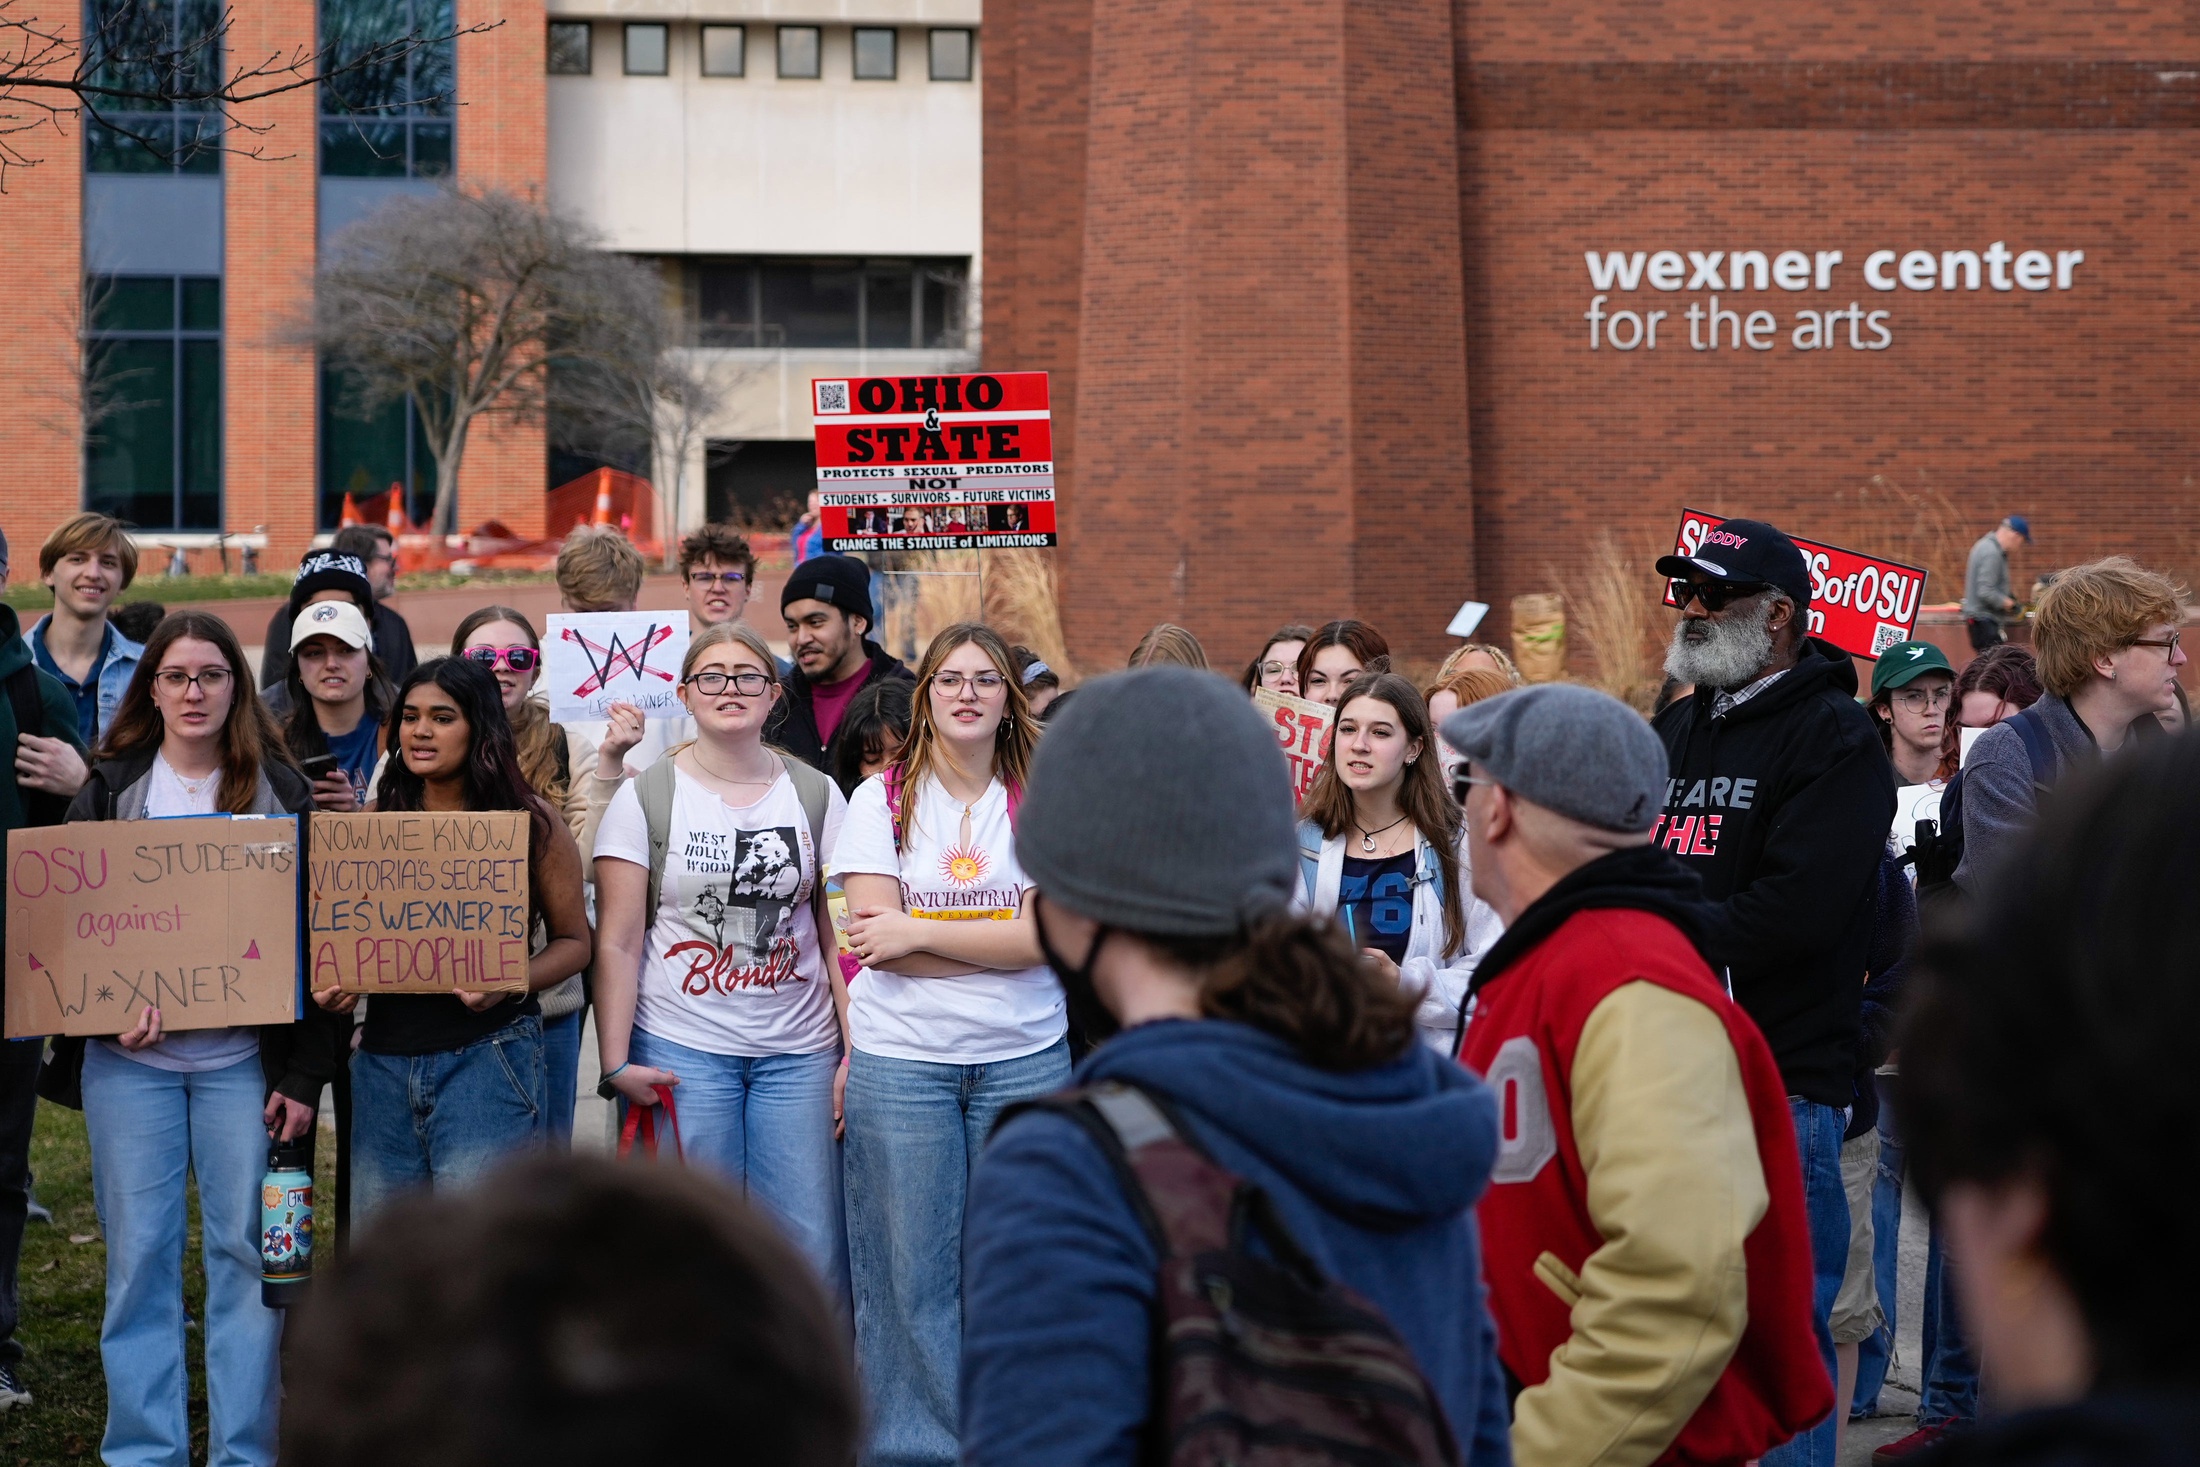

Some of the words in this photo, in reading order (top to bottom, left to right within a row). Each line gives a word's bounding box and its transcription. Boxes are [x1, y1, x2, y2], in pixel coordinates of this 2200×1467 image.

[1584, 249, 1843, 292] wexner
[1863, 241, 2085, 292] center
[1584, 295, 1668, 351] for
[1684, 295, 1778, 351] the
[1791, 302, 1893, 351] arts
[858, 375, 1004, 413] OHIO
[924, 407, 941, 431] &
[846, 425, 1021, 463] STATE
[822, 468, 895, 479] PROTECTS
[903, 466, 957, 477] SEXUAL
[965, 464, 1049, 475] PREDATORS
[909, 478, 962, 490] NOT
[823, 493, 878, 505] STUDENTS
[891, 490, 951, 504] SURVIVORS
[963, 490, 1005, 502] FUTURE
[1008, 489, 1051, 501] VICTIMS
[832, 538, 878, 551] CHANGE
[880, 537, 905, 550] THE
[907, 535, 957, 549] STATUTE
[960, 536, 973, 548] of
[976, 534, 1048, 547] LIMITATIONS
[572, 623, 657, 690] W
[1681, 776, 1758, 810] ARE
[313, 818, 371, 853] NOW
[377, 818, 424, 851] WE
[432, 816, 517, 852] KNOW
[684, 844, 729, 861] HOLLY
[689, 830, 727, 846] WEST
[13, 846, 108, 898] OSU
[133, 842, 296, 884] STUDENTS
[311, 858, 435, 892] VICTORIA'S
[440, 858, 525, 897] SECRET,
[686, 859, 731, 874] WOOD
[311, 900, 373, 932] LES
[378, 900, 494, 933] WEXNER
[498, 904, 525, 939] IS
[1338, 872, 1412, 934] 76
[77, 904, 191, 947] against
[314, 941, 341, 986] A
[355, 936, 523, 986] PEDOPHILE
